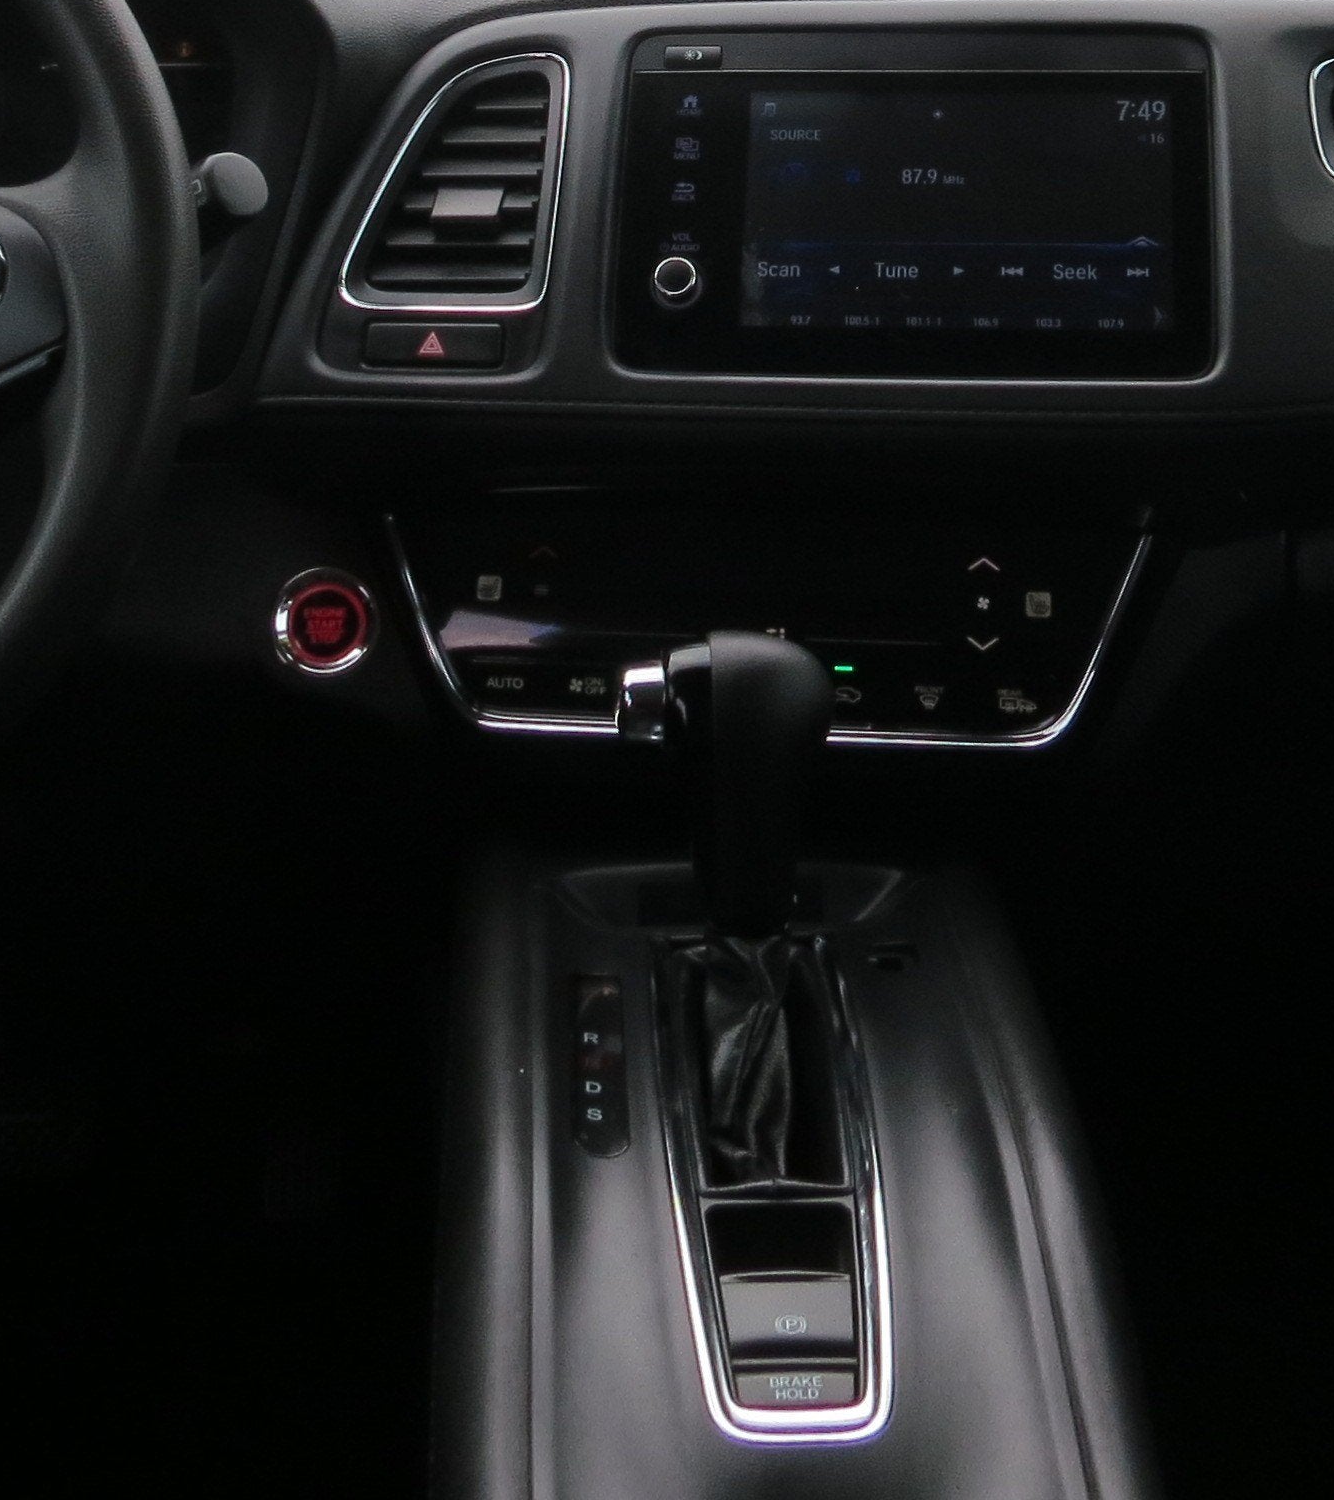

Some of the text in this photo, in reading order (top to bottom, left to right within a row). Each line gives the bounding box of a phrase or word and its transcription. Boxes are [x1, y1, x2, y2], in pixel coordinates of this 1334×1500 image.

[1116, 100, 1166, 121] 7:49
[770, 129, 821, 141] SOURCE
[901, 169, 938, 185] 87.9
[672, 232, 693, 242] VOL
[757, 261, 1098, 280] Scan Tune Seek
[487, 677, 525, 689] AUTO
[583, 1031, 599, 1044] R
[585, 1080, 602, 1094] D
[586, 1107, 603, 1121] S
[769, 1375, 824, 1388] BRAKE
[775, 1388, 820, 1400] HOLD
